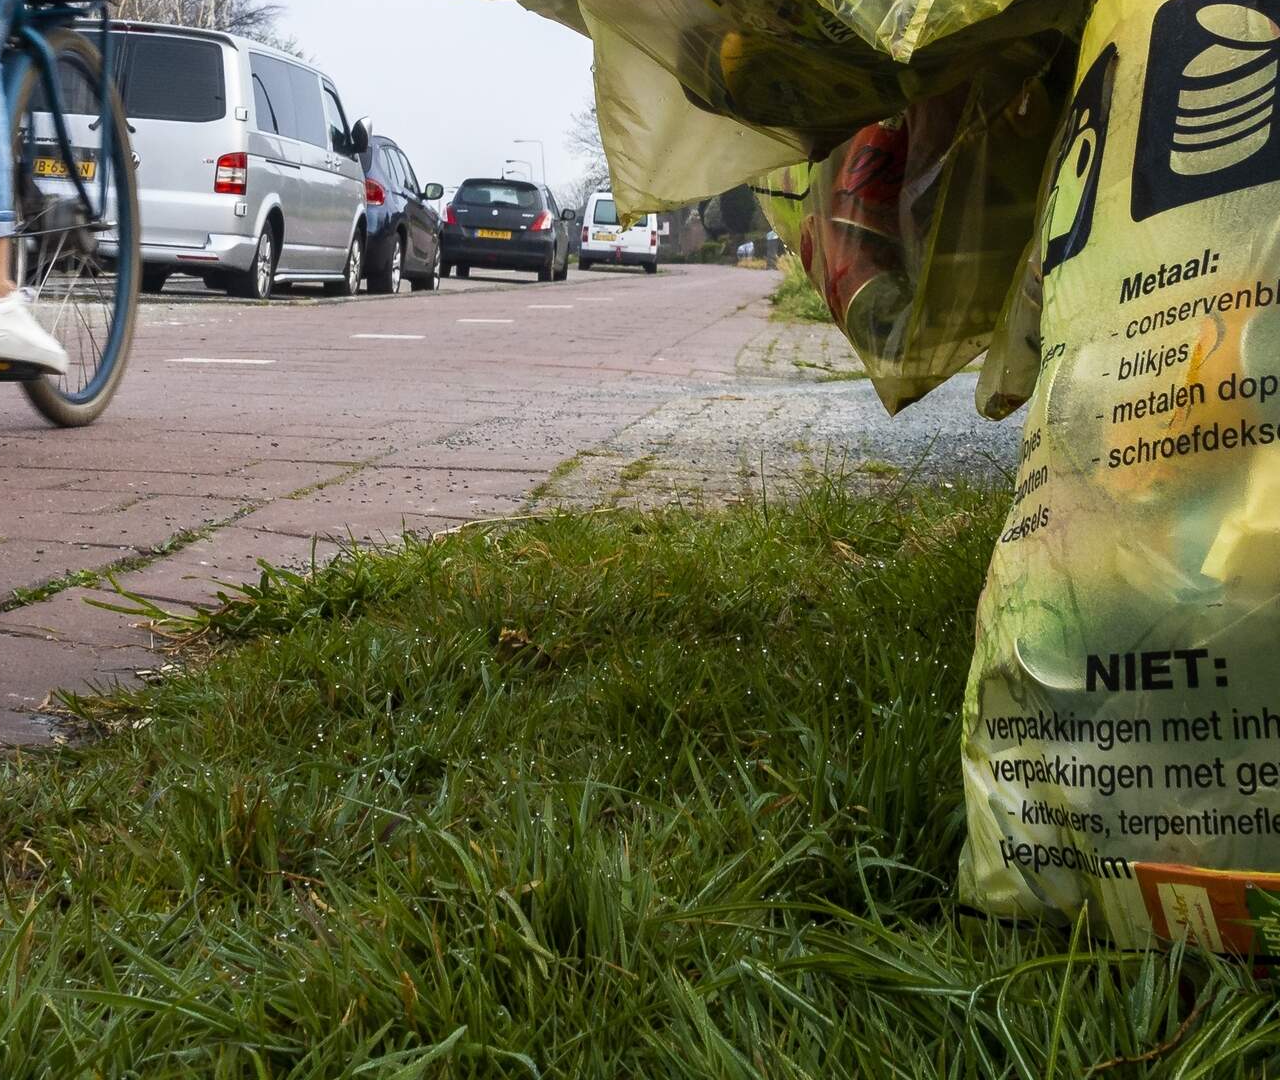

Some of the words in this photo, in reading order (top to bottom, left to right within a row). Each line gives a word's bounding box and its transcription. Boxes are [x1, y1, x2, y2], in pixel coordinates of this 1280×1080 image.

[1120, 248, 1220, 304] Metaal:
[1117, 342, 1190, 381] blikjes
[1111, 380, 1206, 424] metalen
[1085, 648, 1230, 692] NIET:
[985, 709, 1152, 752] verpakkingen
[1162, 710, 1223, 743] met
[989, 753, 1154, 797] verpakkingen
[1165, 756, 1227, 789] met
